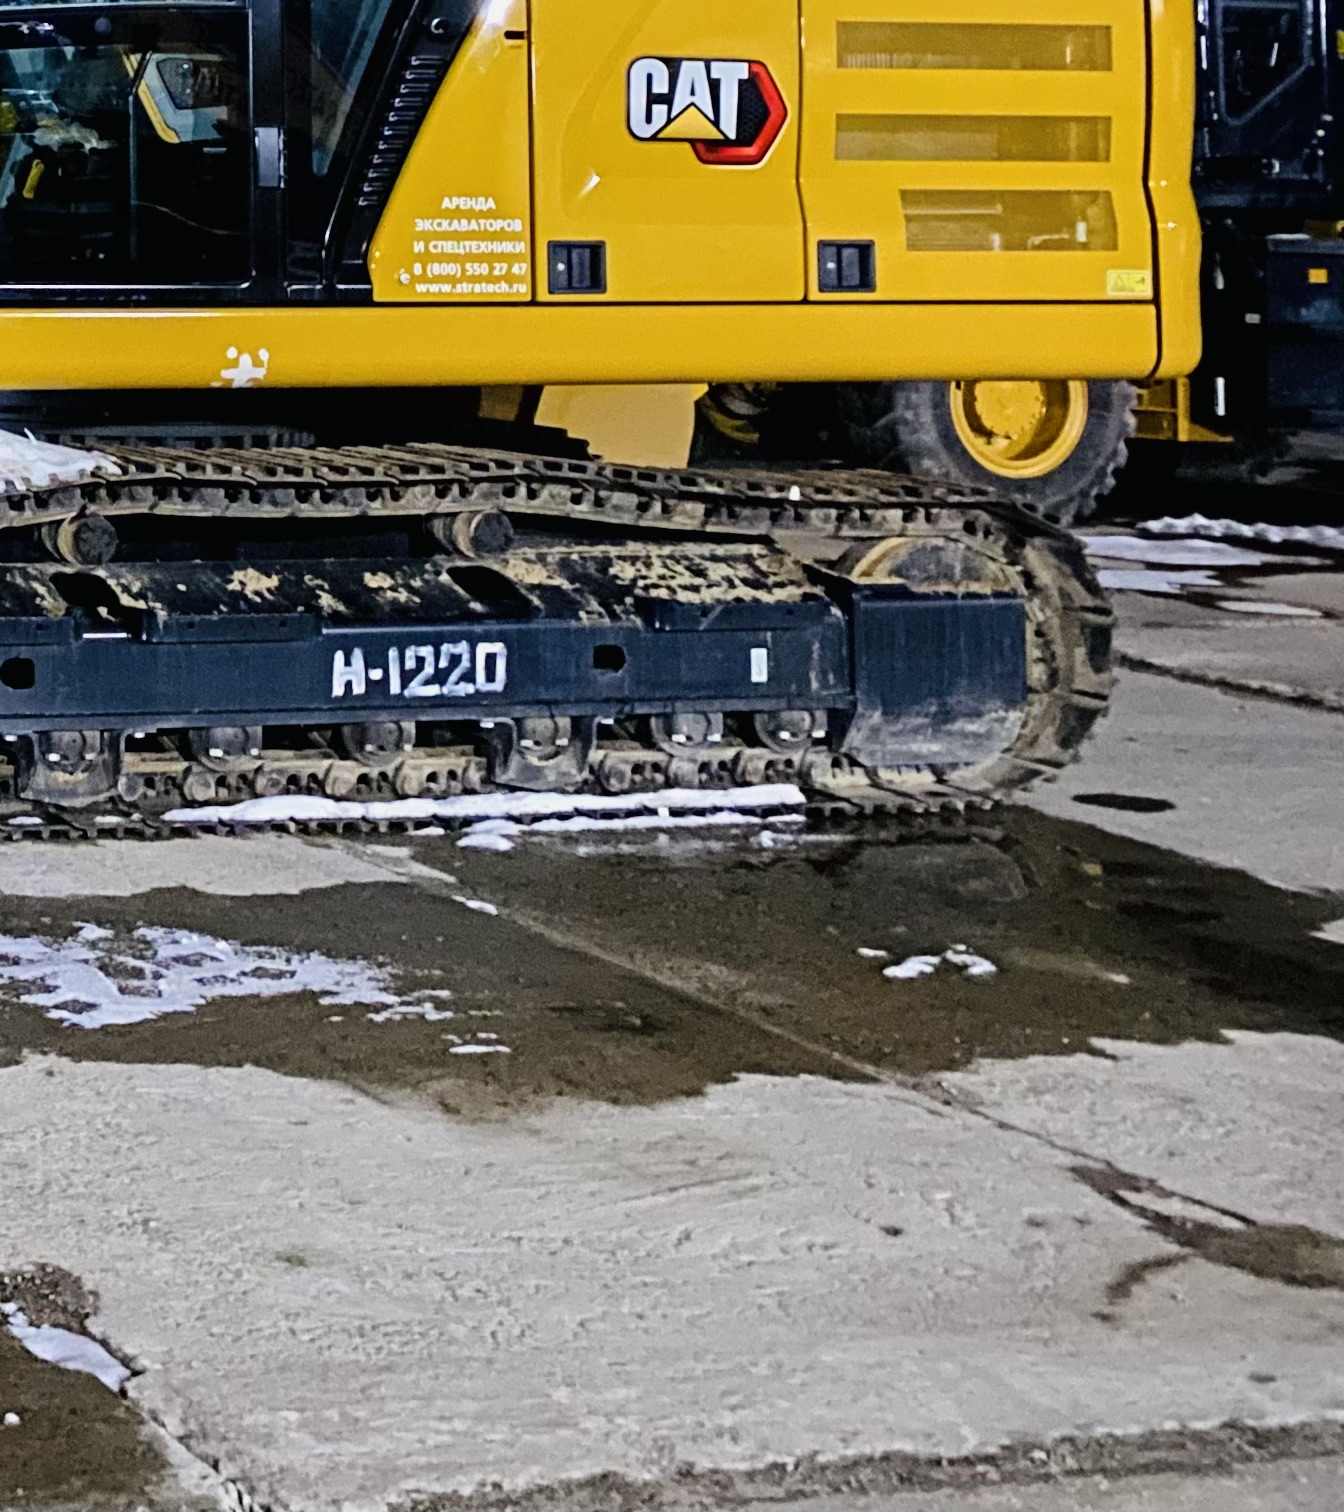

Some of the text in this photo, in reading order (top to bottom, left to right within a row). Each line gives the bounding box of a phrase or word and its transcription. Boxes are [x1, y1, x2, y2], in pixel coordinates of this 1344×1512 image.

[629, 58, 749, 140] CAT
[442, 196, 497, 211] АРЕНДА
[414, 218, 523, 232] ЭКСКАВАТОРОВ
[413, 240, 526, 255] И СПЕЦТЕХНИКИ
[413, 262, 423, 276] 8
[465, 262, 490, 276] 550
[492, 262, 509, 276] 27
[511, 262, 528, 276] 47
[415, 280, 528, 294] www.stratech.ru
